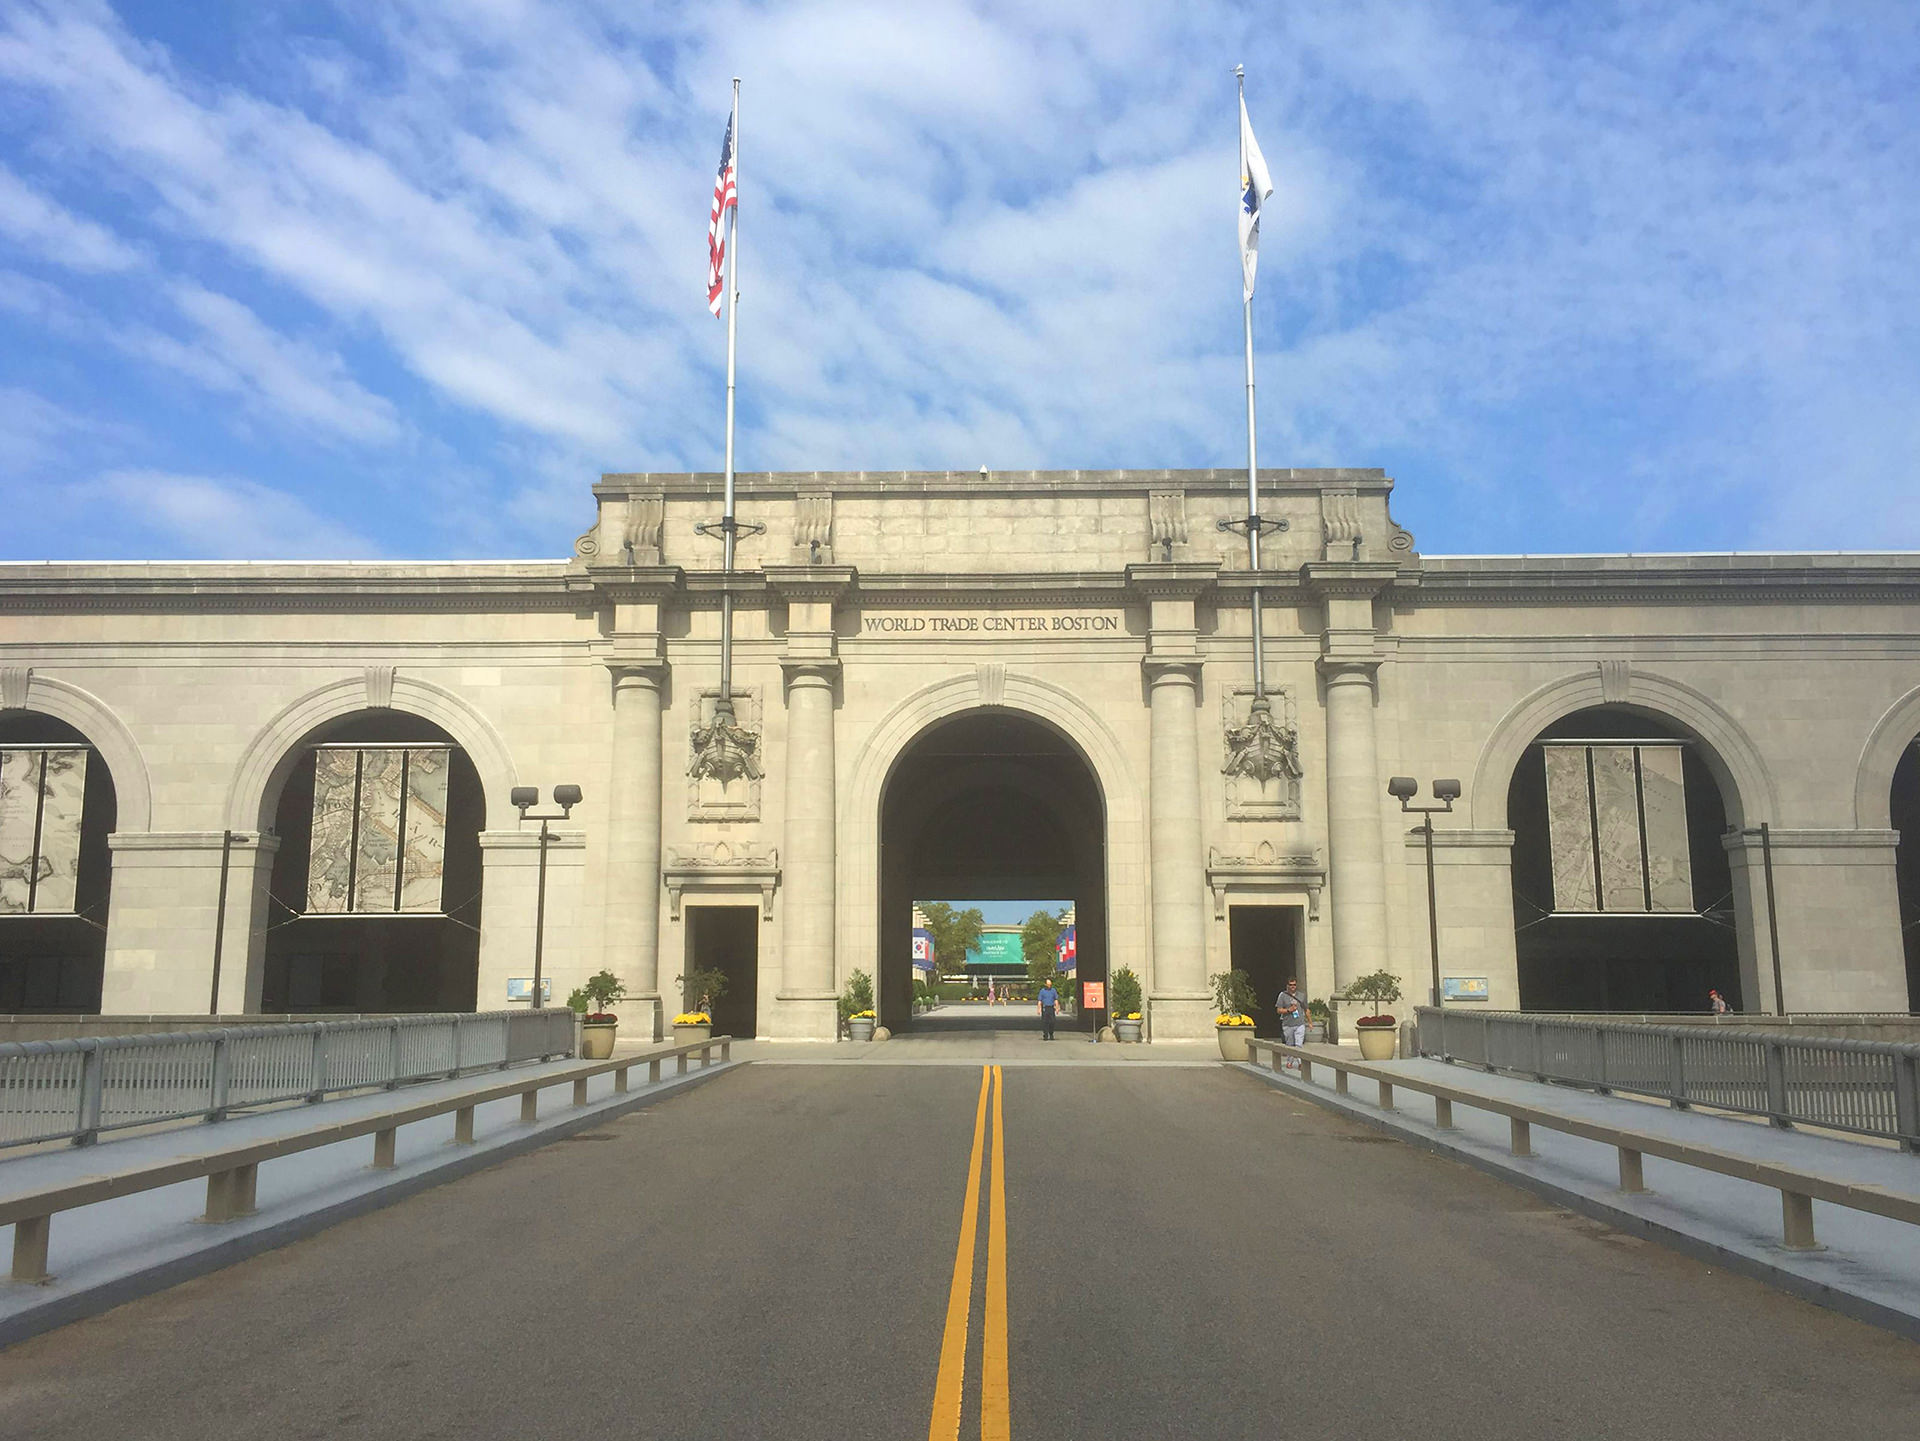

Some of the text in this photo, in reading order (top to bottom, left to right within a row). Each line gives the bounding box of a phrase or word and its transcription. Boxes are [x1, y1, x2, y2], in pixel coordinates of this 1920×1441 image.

[864, 615, 1119, 632] WORLD TRADE CENTER BOSTON
